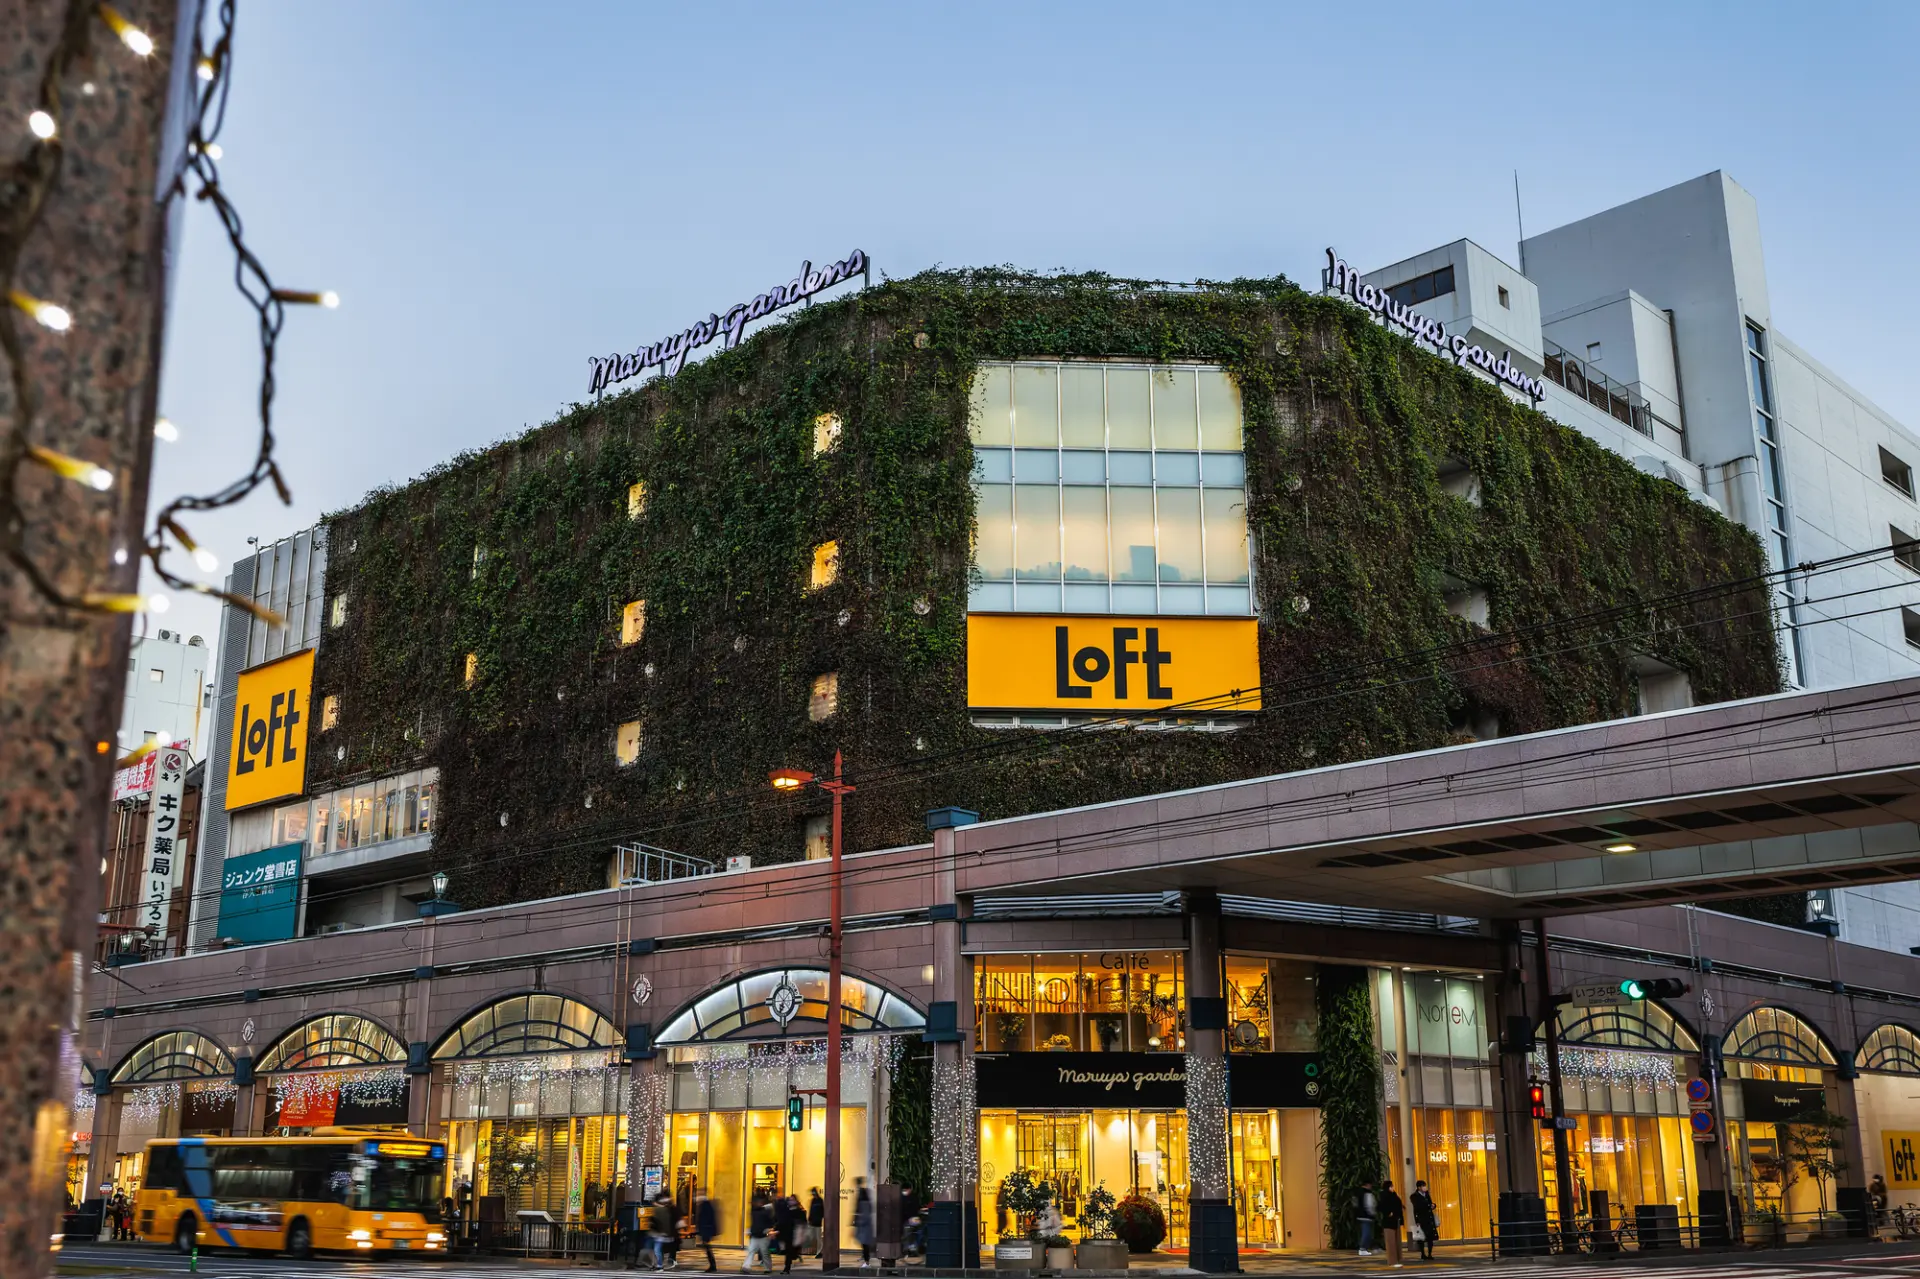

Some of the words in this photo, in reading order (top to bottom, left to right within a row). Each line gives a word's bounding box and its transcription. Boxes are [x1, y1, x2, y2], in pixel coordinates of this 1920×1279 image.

[151, 794, 178, 876] キク薬局
[225, 859, 297, 889] ジュンク堂書店
[1058, 1068, 1131, 1091] Maruya
[1132, 1067, 1191, 1091] garden
